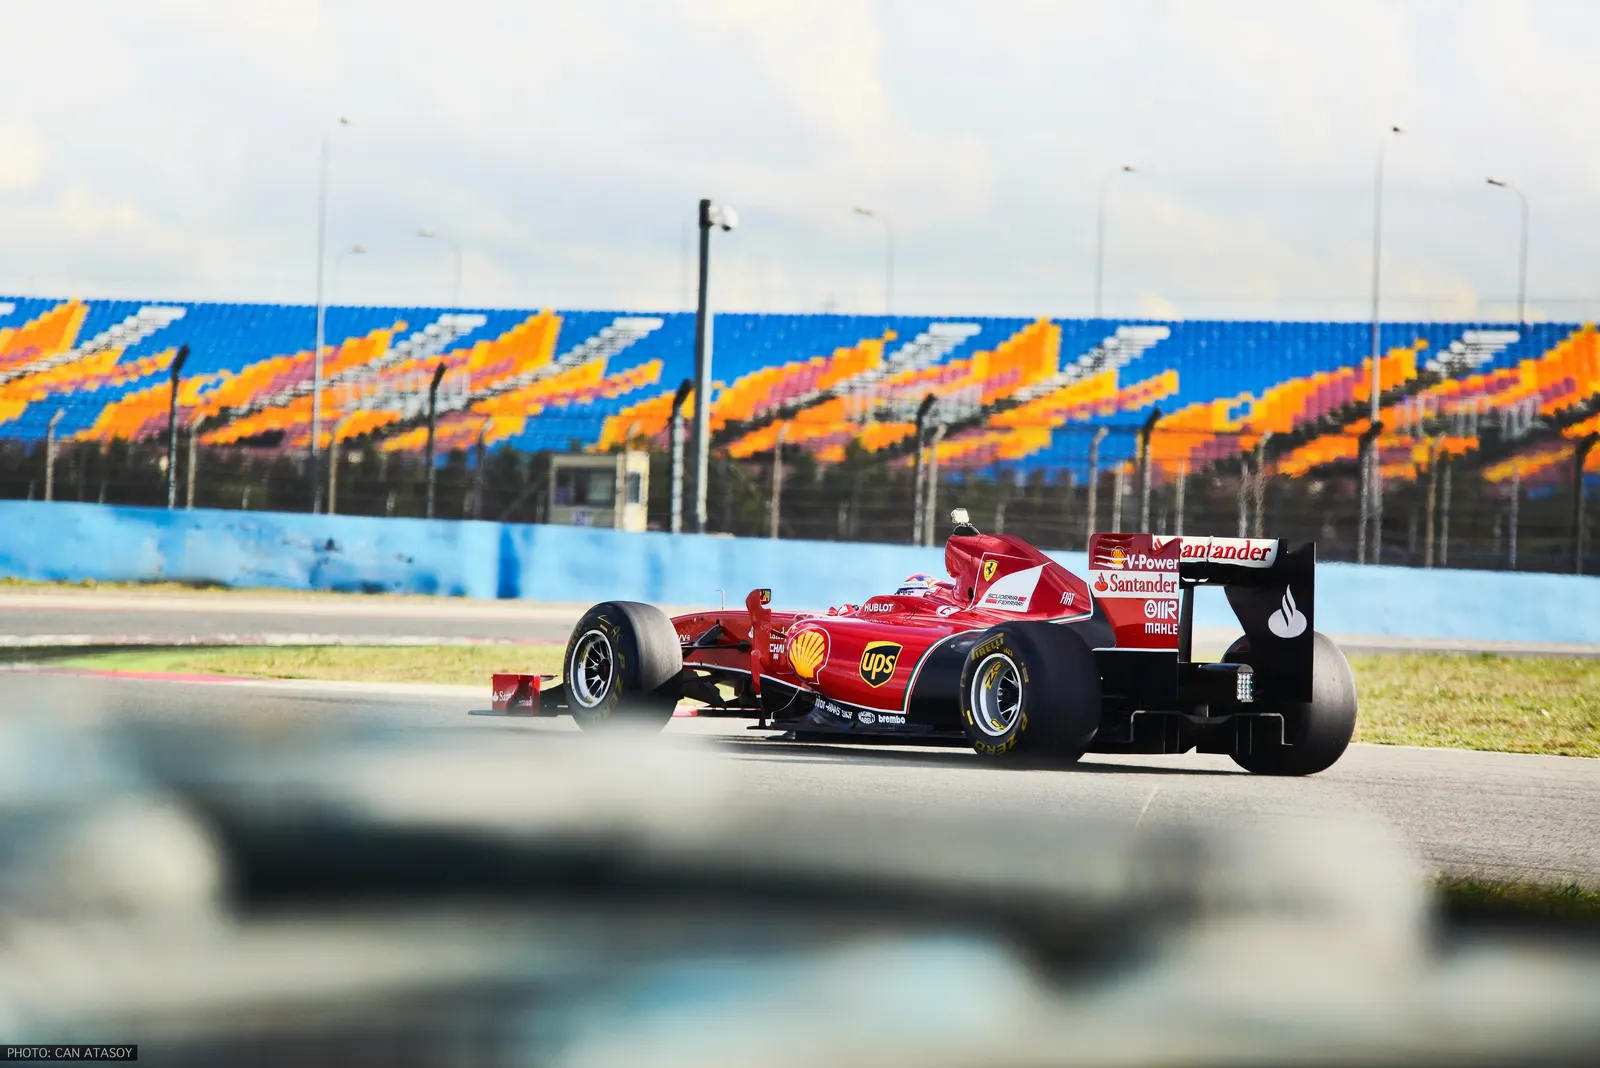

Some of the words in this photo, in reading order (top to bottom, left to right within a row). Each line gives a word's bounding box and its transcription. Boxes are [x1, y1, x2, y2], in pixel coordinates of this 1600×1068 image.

[1180, 538, 1272, 562] antander
[1126, 554, 1179, 569] V-Power
[1110, 573, 1177, 593] Santander
[988, 593, 1018, 601] SCUDERIA
[997, 599, 1024, 607] FERRARI
[1060, 591, 1075, 606] FIAT
[864, 603, 894, 613] HUBLOT
[1145, 622, 1178, 635] MAHLE
[862, 652, 896, 680] ups
[878, 714, 906, 724] brembo
